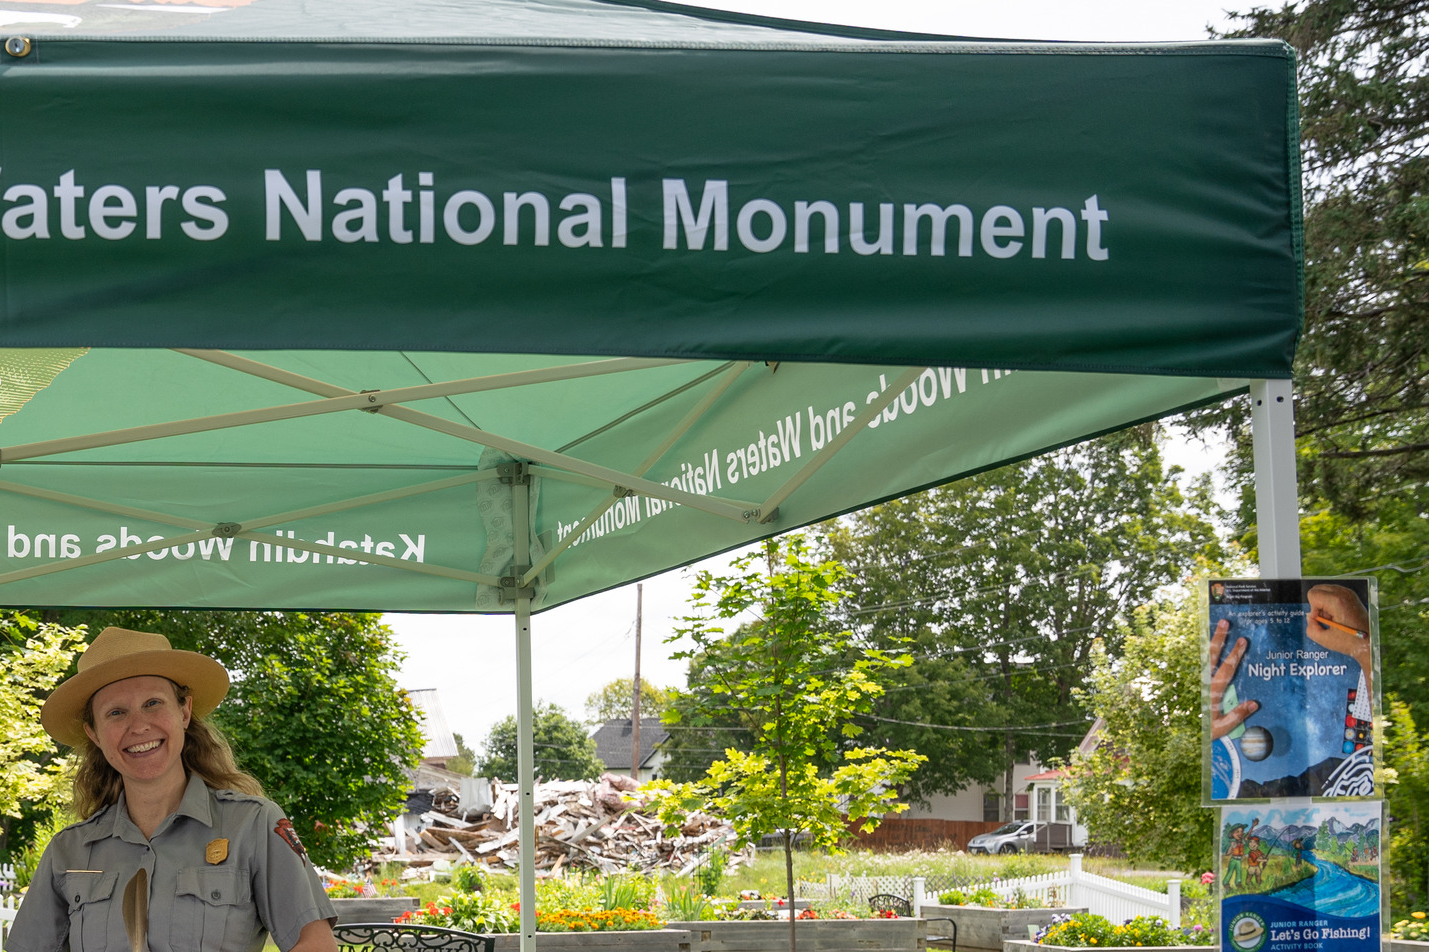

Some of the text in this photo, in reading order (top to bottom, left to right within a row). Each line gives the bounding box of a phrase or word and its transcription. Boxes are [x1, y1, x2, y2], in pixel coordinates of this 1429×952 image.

[263, 167, 627, 249] National
[662, 178, 1110, 262] Monument
[1266, 650, 1328, 660] Junior Ranger
[1248, 663, 1347, 680] Night Explorer
[1271, 926, 1370, 941] Let's Go Fishing!
